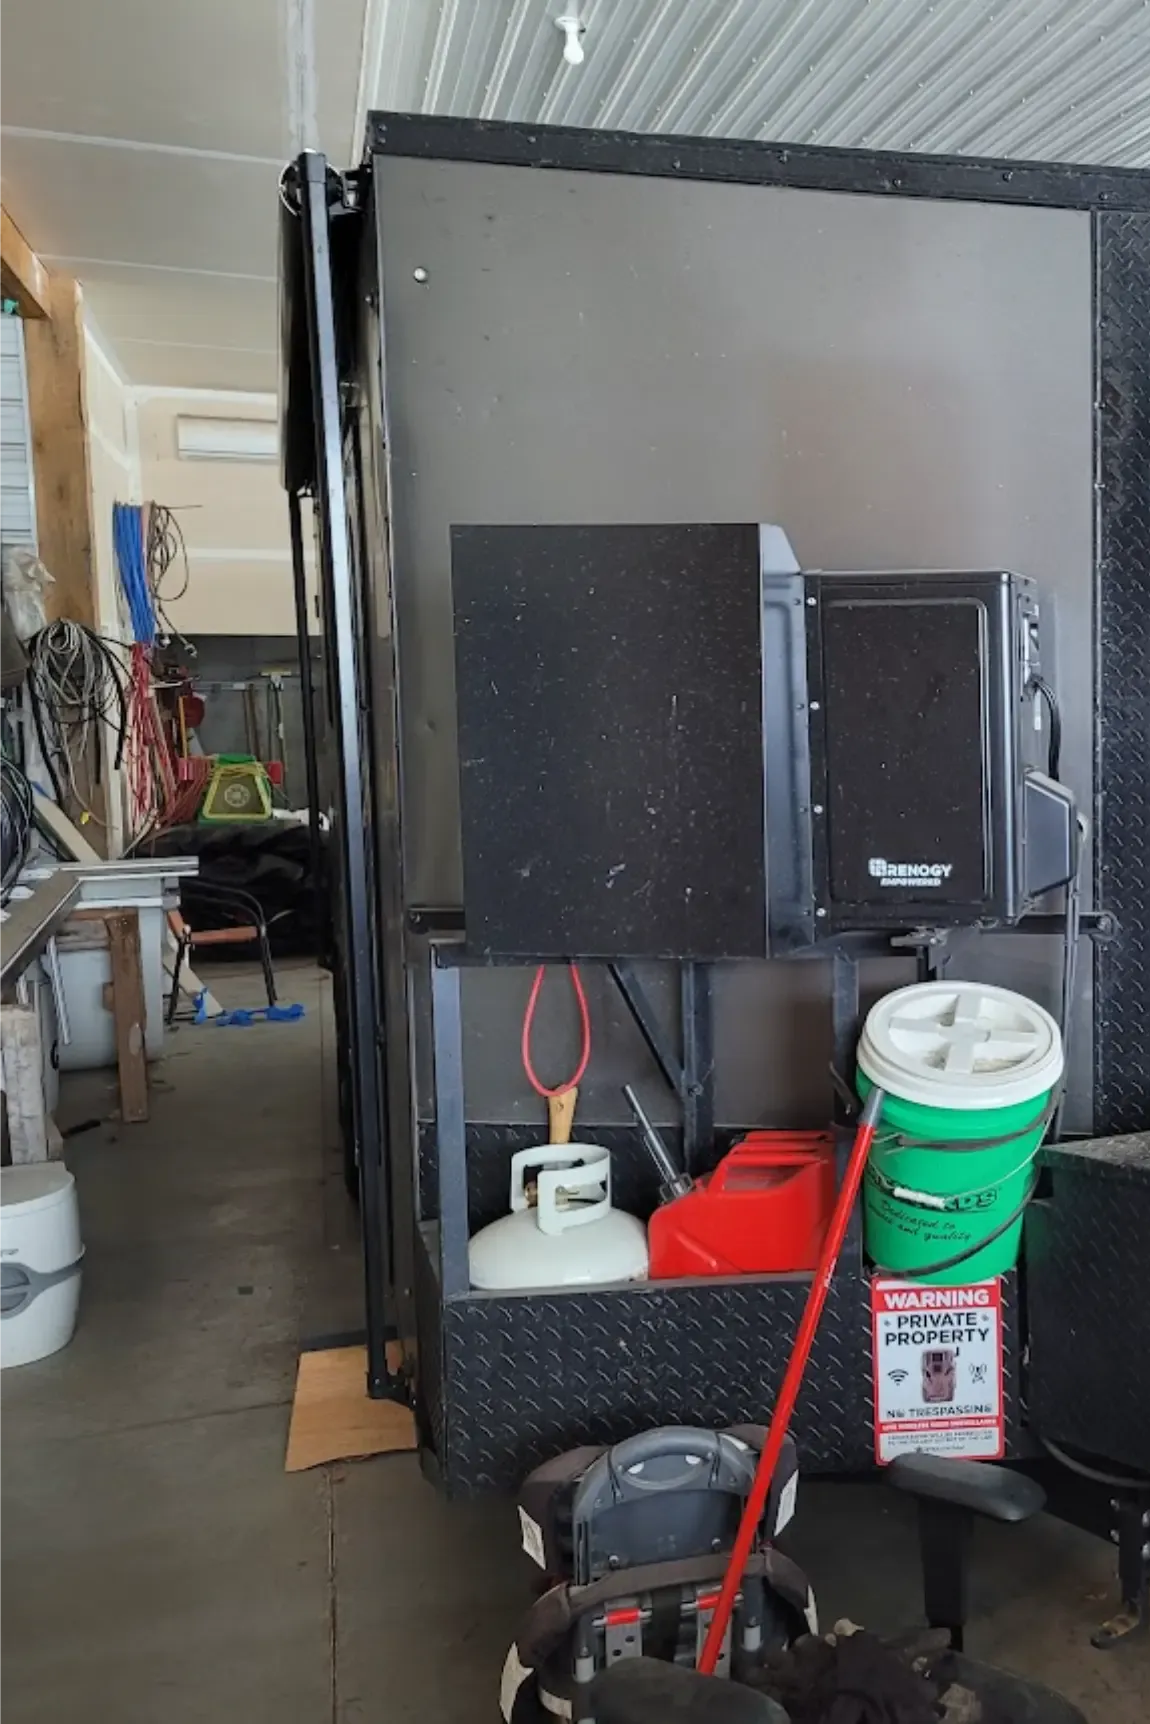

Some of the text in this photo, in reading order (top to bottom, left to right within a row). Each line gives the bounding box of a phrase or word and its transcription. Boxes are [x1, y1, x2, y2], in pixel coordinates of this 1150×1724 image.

[887, 863, 953, 877] RENOGY
[879, 877, 942, 887] EMPOWERED
[881, 1199, 939, 1229] Dedicated
[942, 1220, 956, 1229] to
[923, 1231, 971, 1243] quality
[884, 1289, 990, 1309] WARNING
[897, 1312, 977, 1329] PRIVATE
[885, 1327, 990, 1347] PROPERTY
[886, 1404, 993, 1419] NO TRESPASSING
